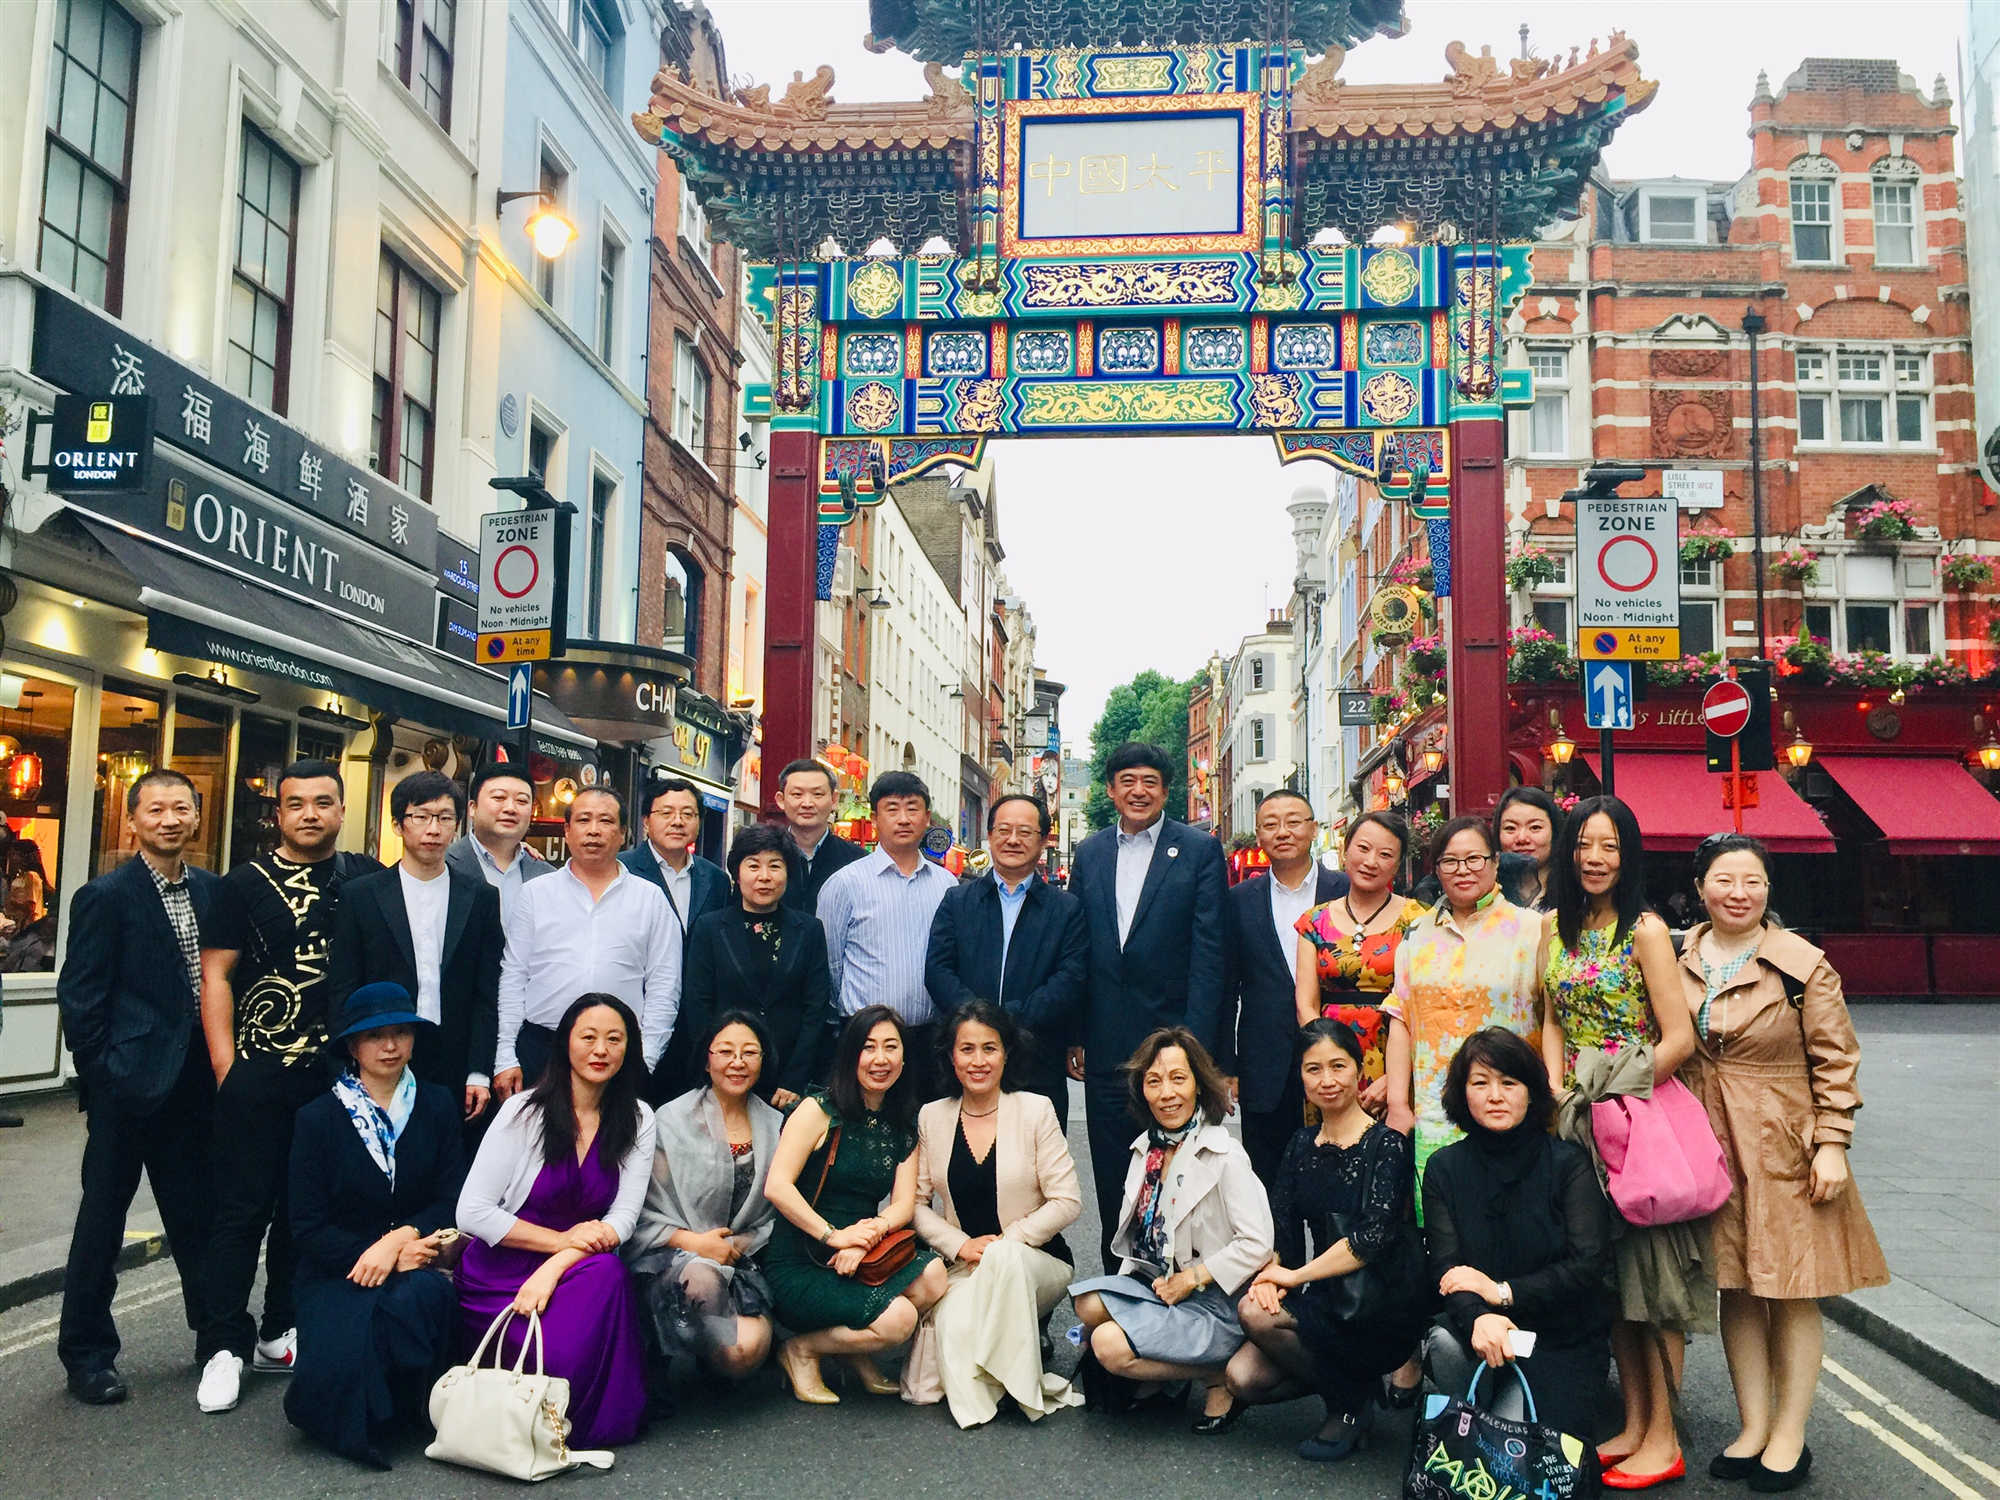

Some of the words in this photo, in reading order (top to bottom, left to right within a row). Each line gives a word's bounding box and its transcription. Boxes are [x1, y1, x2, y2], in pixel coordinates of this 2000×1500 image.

[54, 451, 138, 468] ORIENT
[74, 470, 117, 480] LONDON
[1667, 481, 1695, 489] STREET
[1587, 503, 1668, 513] PEDESTRIAN
[488, 513, 548, 527] PEDESTRIAN
[1598, 516, 1656, 531] ZONE
[496, 526, 539, 543] ZONE
[193, 493, 340, 593] ORIENT
[340, 580, 385, 615] LONDON
[459, 559, 468, 575] 15
[490, 606, 502, 614] No
[505, 602, 540, 614] vehicles
[1594, 598, 1611, 608] No
[1615, 598, 1662, 608] vehicles
[480, 619, 503, 628] Noon
[510, 615, 548, 628] Midnight
[1583, 612, 1614, 622] Noon
[1623, 612, 1674, 624] Midnight
[512, 637, 523, 646] At
[525, 636, 540, 647] any
[1628, 633, 1643, 643] At
[1646, 635, 1666, 645] any
[517, 646, 535, 656] time
[1634, 644, 1660, 654] time
[206, 641, 333, 688] www.orientlondon.com
[1657, 709, 1705, 725] Little
[694, 733, 711, 769] 97
